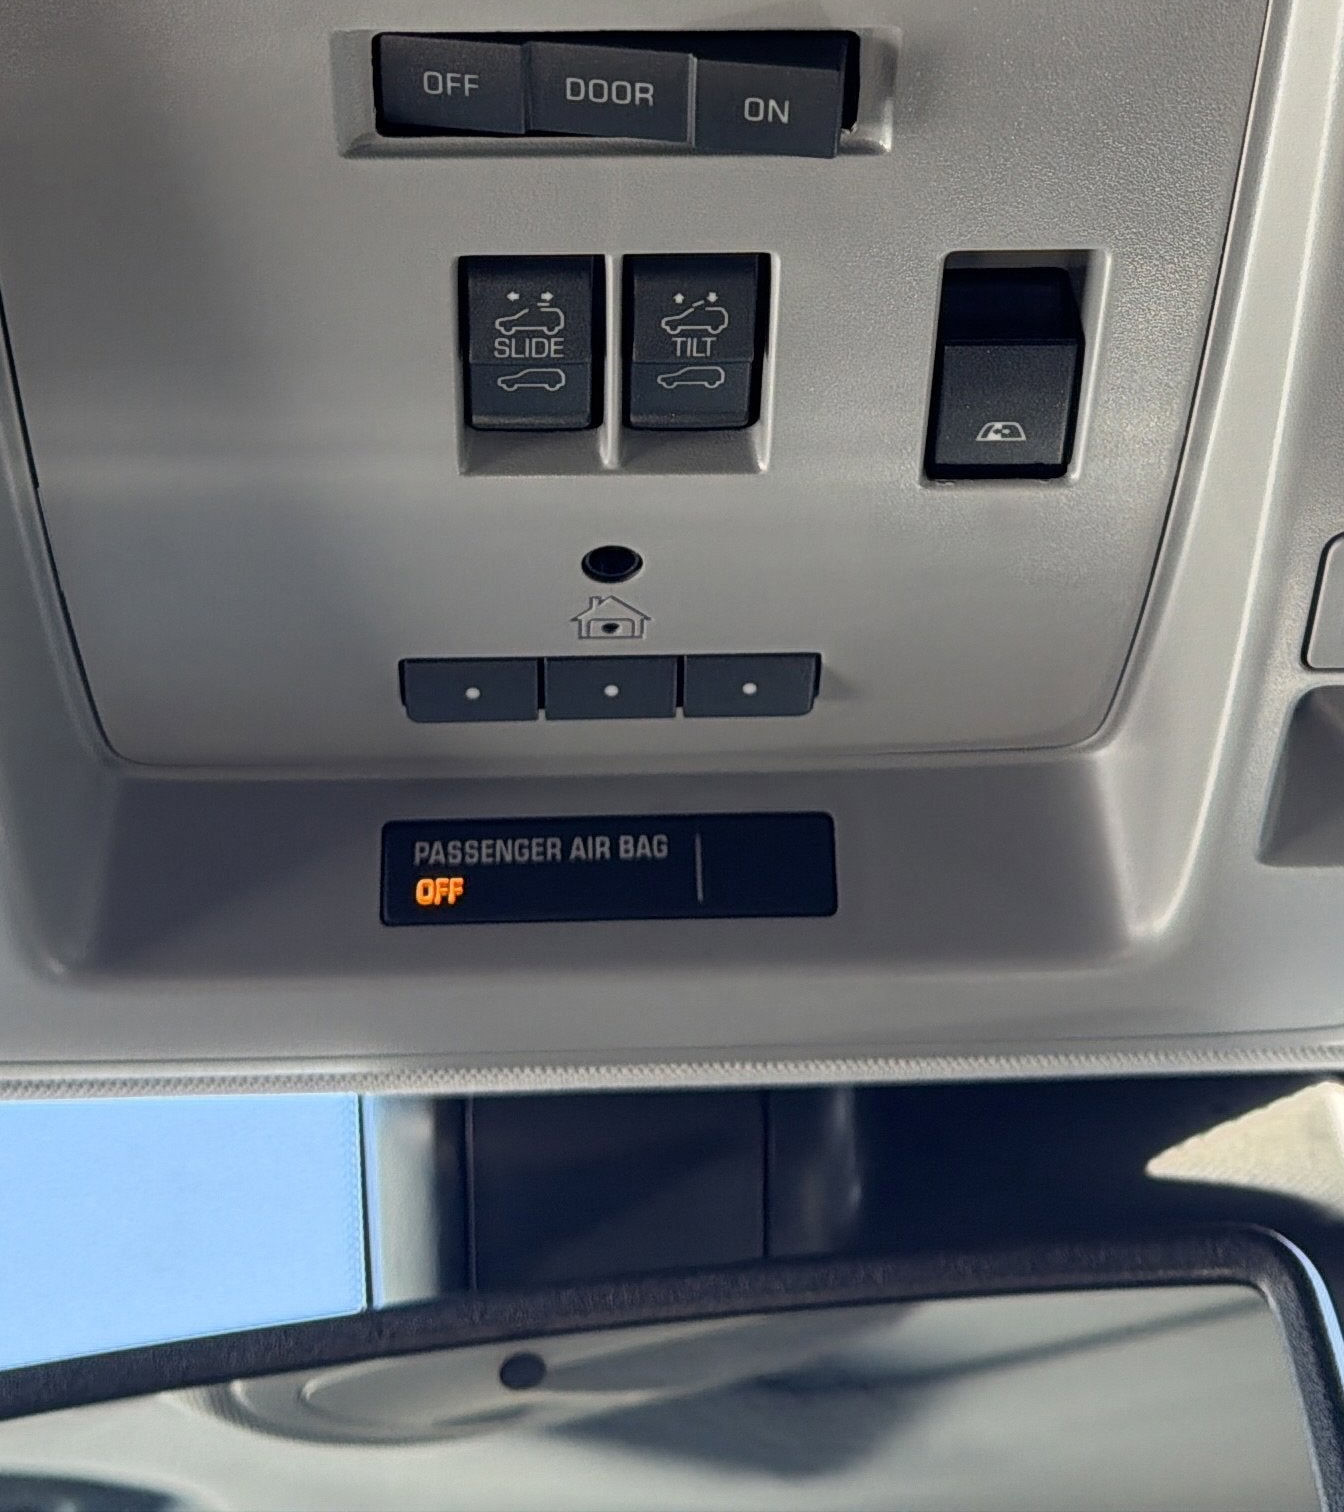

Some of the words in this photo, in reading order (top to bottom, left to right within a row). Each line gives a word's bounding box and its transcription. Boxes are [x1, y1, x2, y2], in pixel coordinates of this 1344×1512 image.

[422, 70, 480, 98] OFF
[565, 76, 655, 107] DOOR
[743, 97, 790, 125] ON
[494, 337, 565, 359] SLIDE
[671, 337, 717, 357] TILT
[413, 836, 562, 867] PASSENGER
[569, 836, 612, 863] AIR
[618, 833, 669, 861] BAG
[414, 876, 465, 906] OFF
